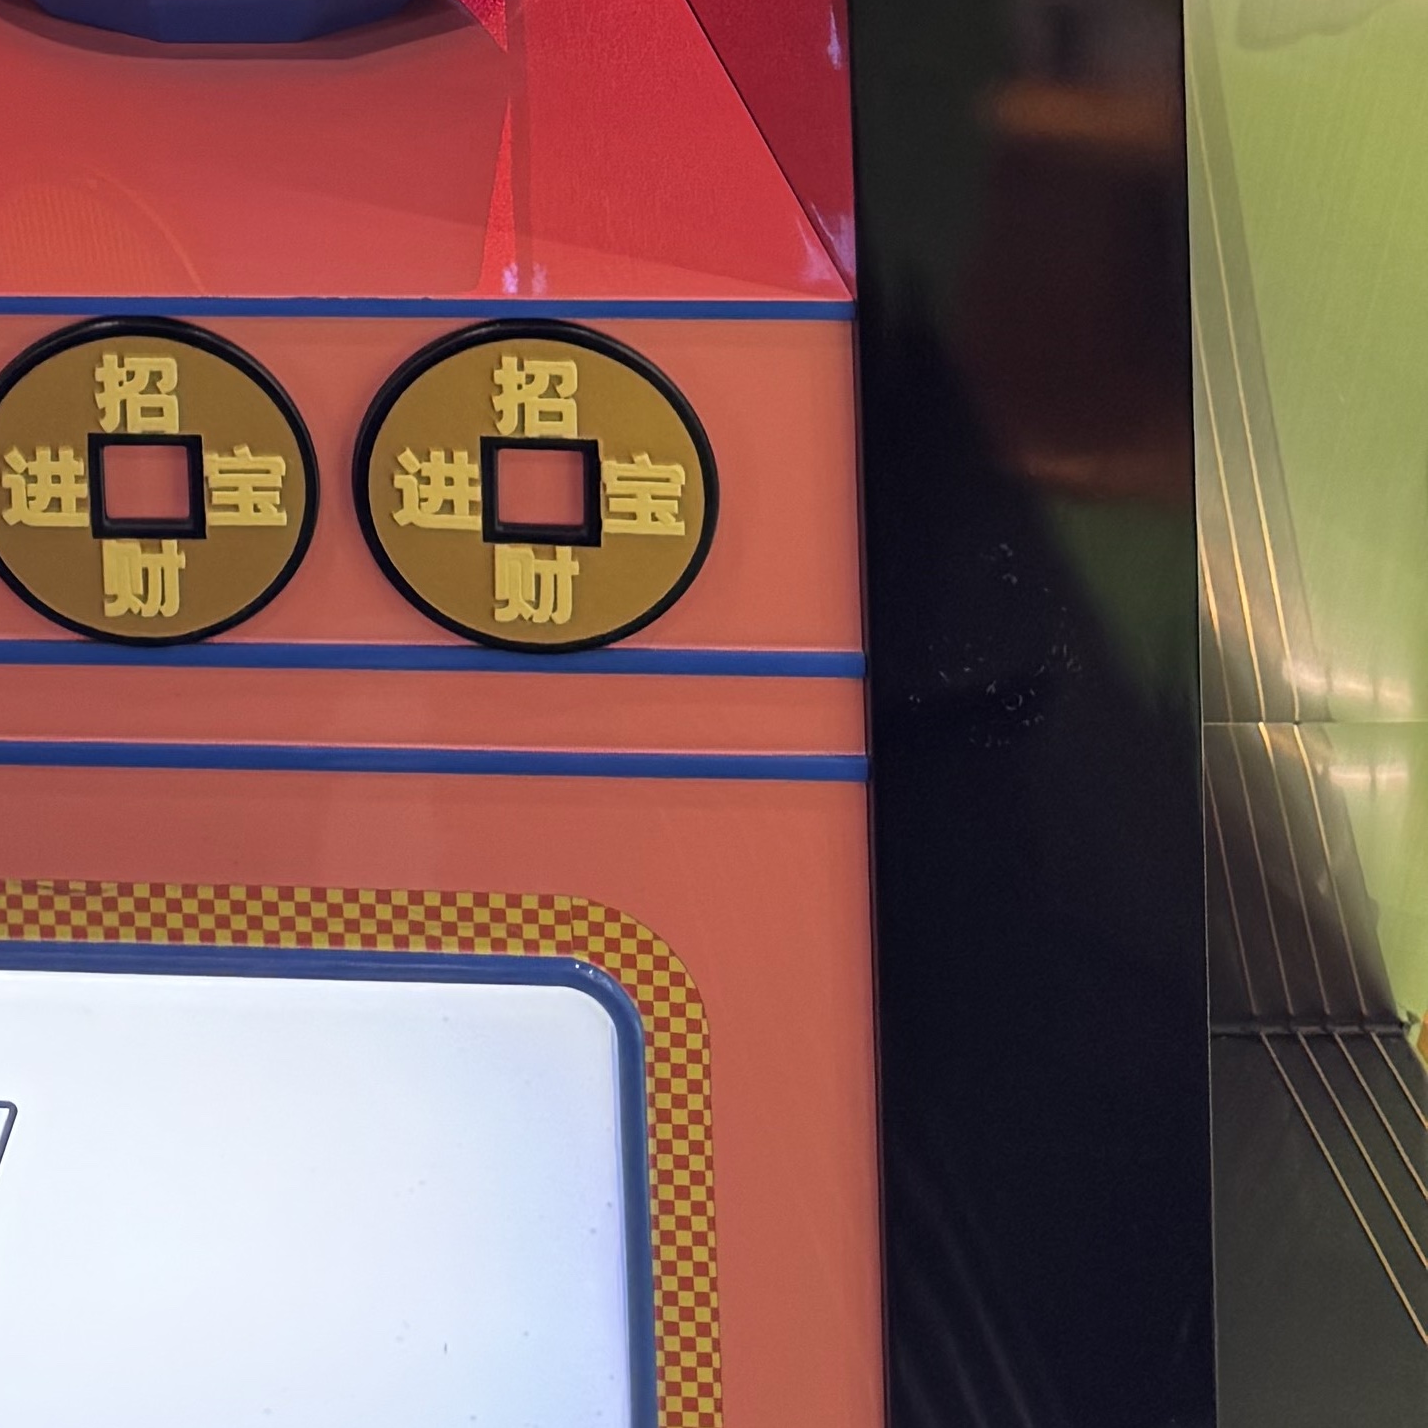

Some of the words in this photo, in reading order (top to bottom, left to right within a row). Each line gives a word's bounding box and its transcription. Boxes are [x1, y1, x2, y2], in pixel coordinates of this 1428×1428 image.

[95, 353, 179, 435] 招
[493, 355, 579, 439] 招
[0, 445, 90, 529] 进
[203, 445, 288, 527] 宝
[392, 447, 482, 530] 进
[601, 452, 687, 536] 宝
[102, 539, 186, 618] 财
[493, 545, 580, 625] 财
